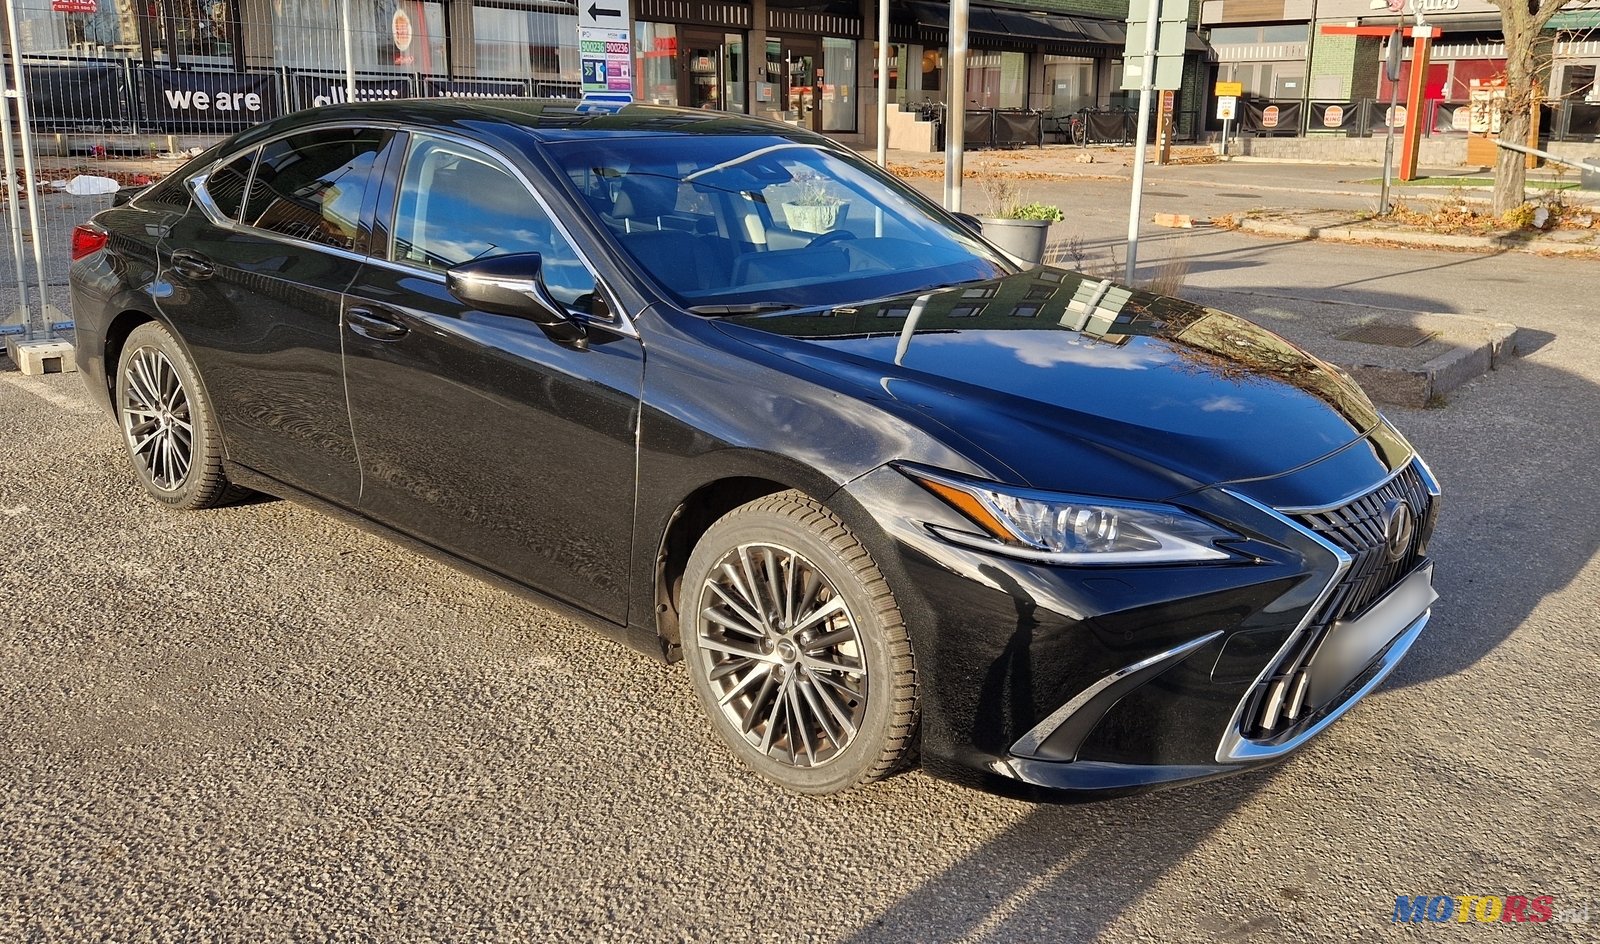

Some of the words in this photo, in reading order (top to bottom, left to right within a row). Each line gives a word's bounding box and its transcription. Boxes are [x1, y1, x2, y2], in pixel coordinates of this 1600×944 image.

[582, 41, 605, 53] 900236
[606, 42, 629, 54] 900236
[165, 90, 210, 110] we
[215, 91, 261, 111] are
